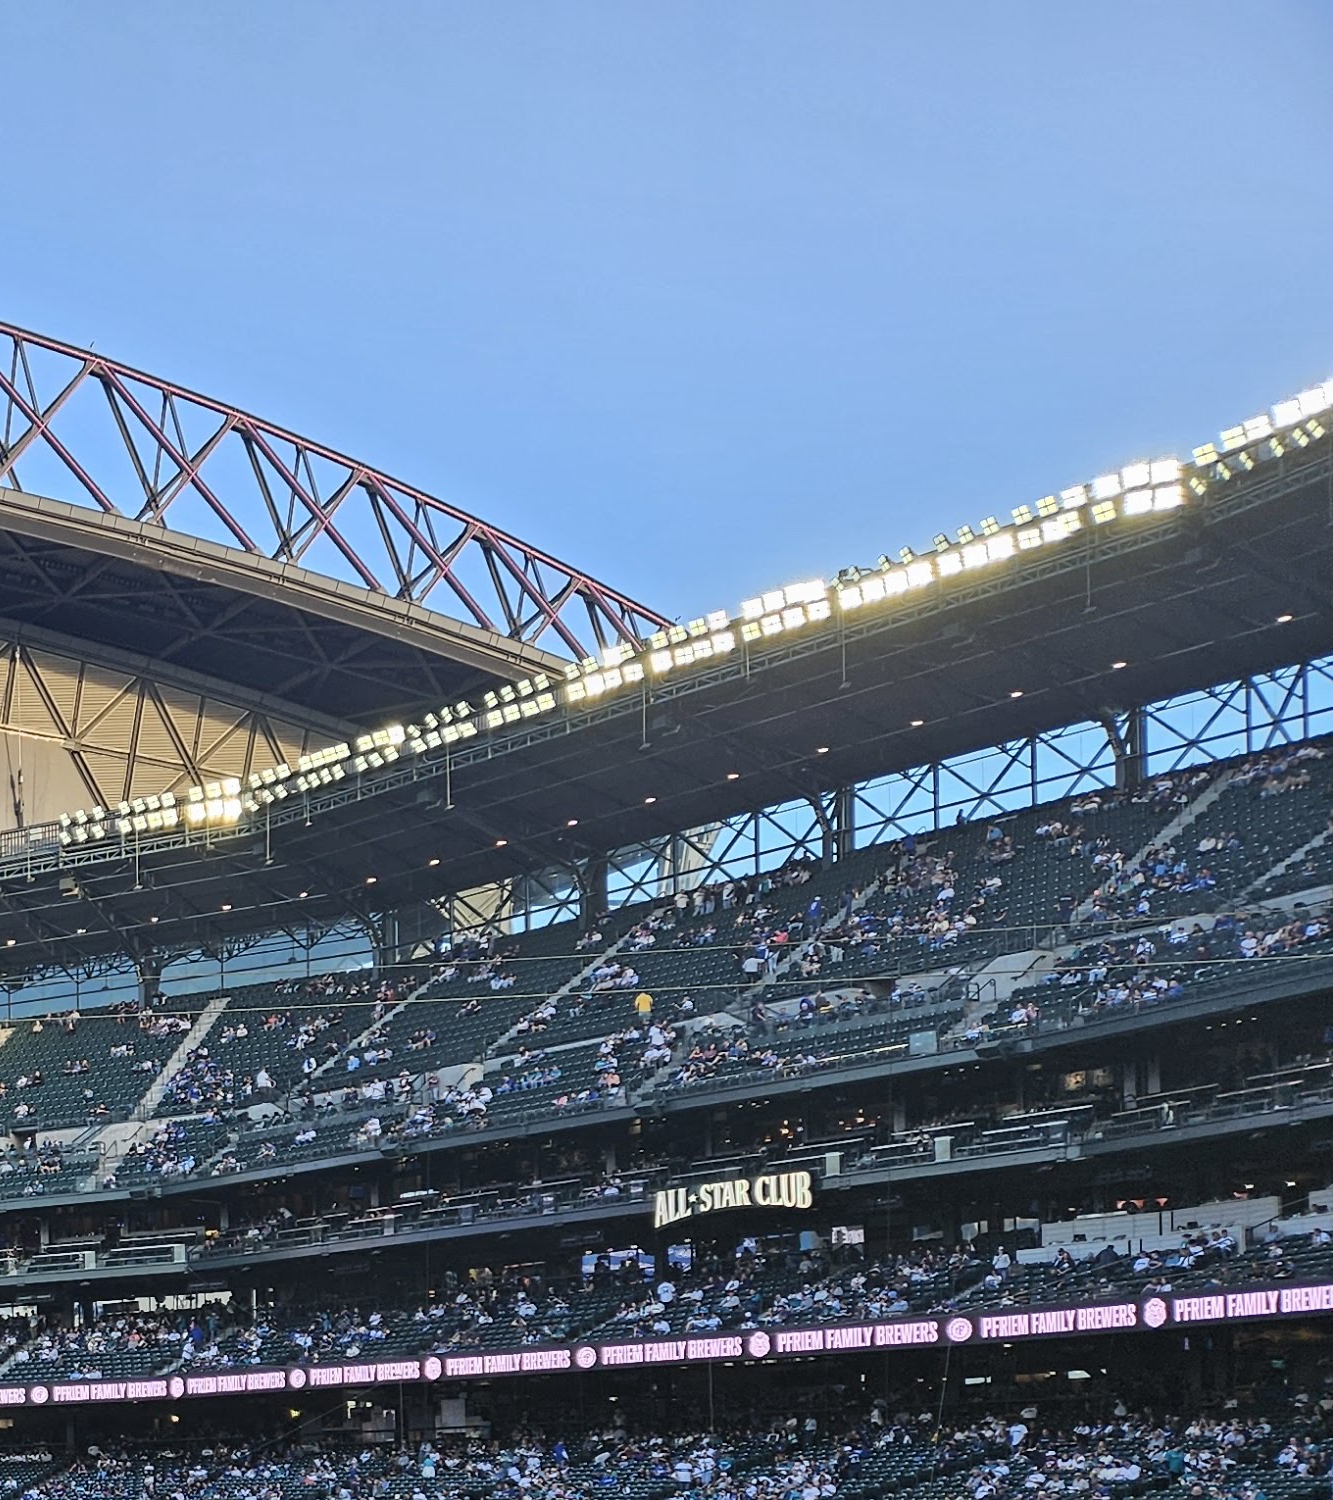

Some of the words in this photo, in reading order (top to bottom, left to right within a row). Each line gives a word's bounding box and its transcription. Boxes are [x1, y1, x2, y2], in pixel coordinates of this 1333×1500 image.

[654, 1187, 692, 1228] ALL
[699, 1178, 752, 1212] STAR
[754, 1171, 813, 1208] CLUB
[777, 1330, 823, 1353] PFRIEM
[825, 1326, 873, 1350] FAMILY
[874, 1321, 938, 1346] BREWERS
